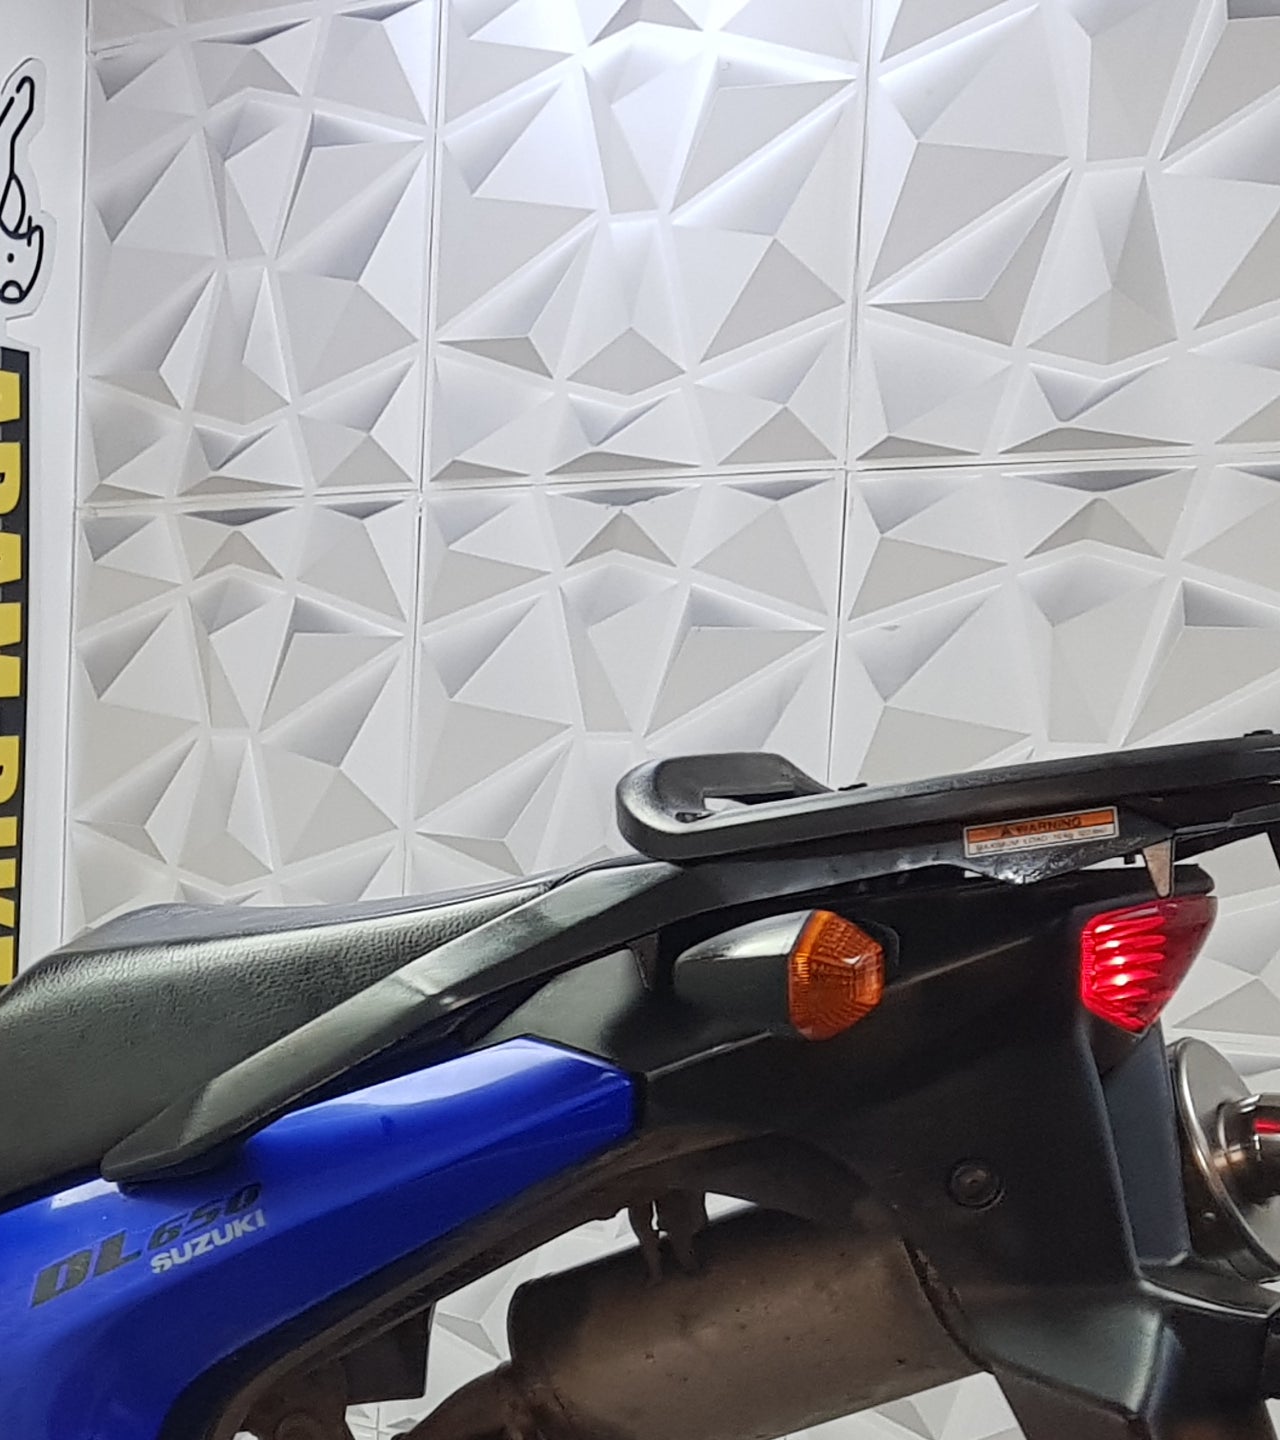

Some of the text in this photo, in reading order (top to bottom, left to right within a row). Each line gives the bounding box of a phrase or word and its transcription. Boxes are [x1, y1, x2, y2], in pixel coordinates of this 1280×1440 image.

[30, 1182, 263, 1309] DL 650
[149, 1208, 268, 1275] SUZUKI
